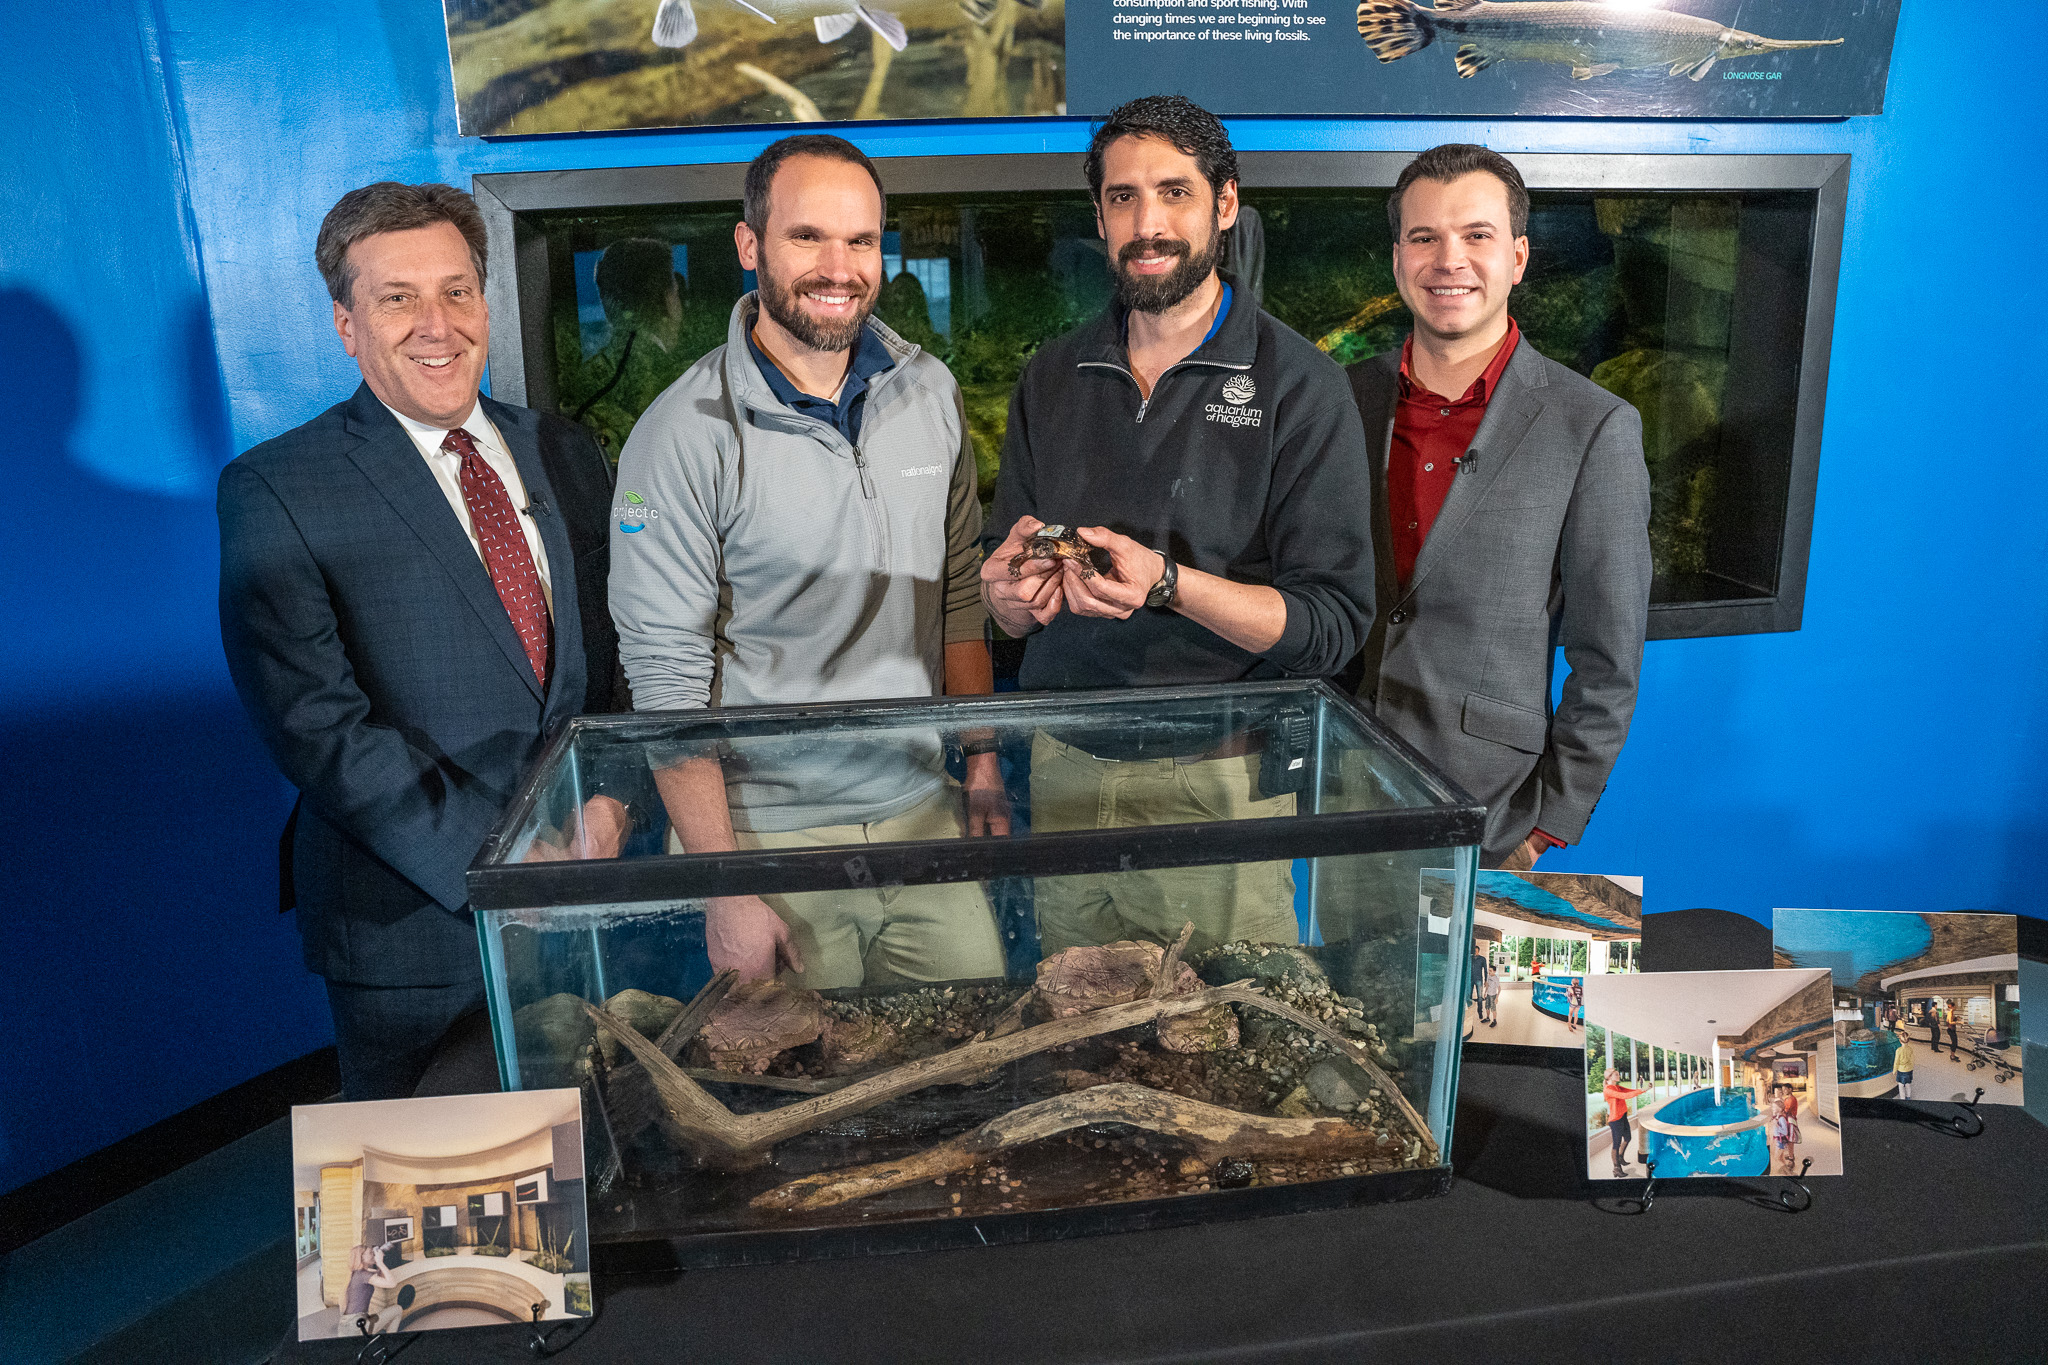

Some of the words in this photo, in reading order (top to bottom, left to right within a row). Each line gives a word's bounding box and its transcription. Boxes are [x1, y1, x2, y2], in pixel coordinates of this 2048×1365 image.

[1113, 0, 1184, 9] consumption
[1210, 0, 1239, 9] sport
[1241, 0, 1280, 11] fishing.
[1282, 0, 1308, 8] With
[1113, 13, 1163, 26] changing
[1165, 13, 1196, 24] times
[1198, 15, 1216, 24] we
[1218, 15, 1235, 24] are
[1238, 13, 1290, 27] beginning
[1293, 14, 1304, 24] to
[1307, 16, 1326, 25] see
[1113, 29, 1132, 40] the
[1134, 29, 1196, 42] importance
[1198, 29, 1210, 40] of
[1212, 29, 1242, 40] these
[1244, 29, 1272, 43] living
[1275, 29, 1311, 41] fossils.
[1723, 71, 1765, 80] LONGNOSE
[1765, 71, 1782, 80] GAR
[1205, 403, 1263, 418] aquarium
[1206, 413, 1216, 422] of
[1216, 412, 1261, 428] niagara
